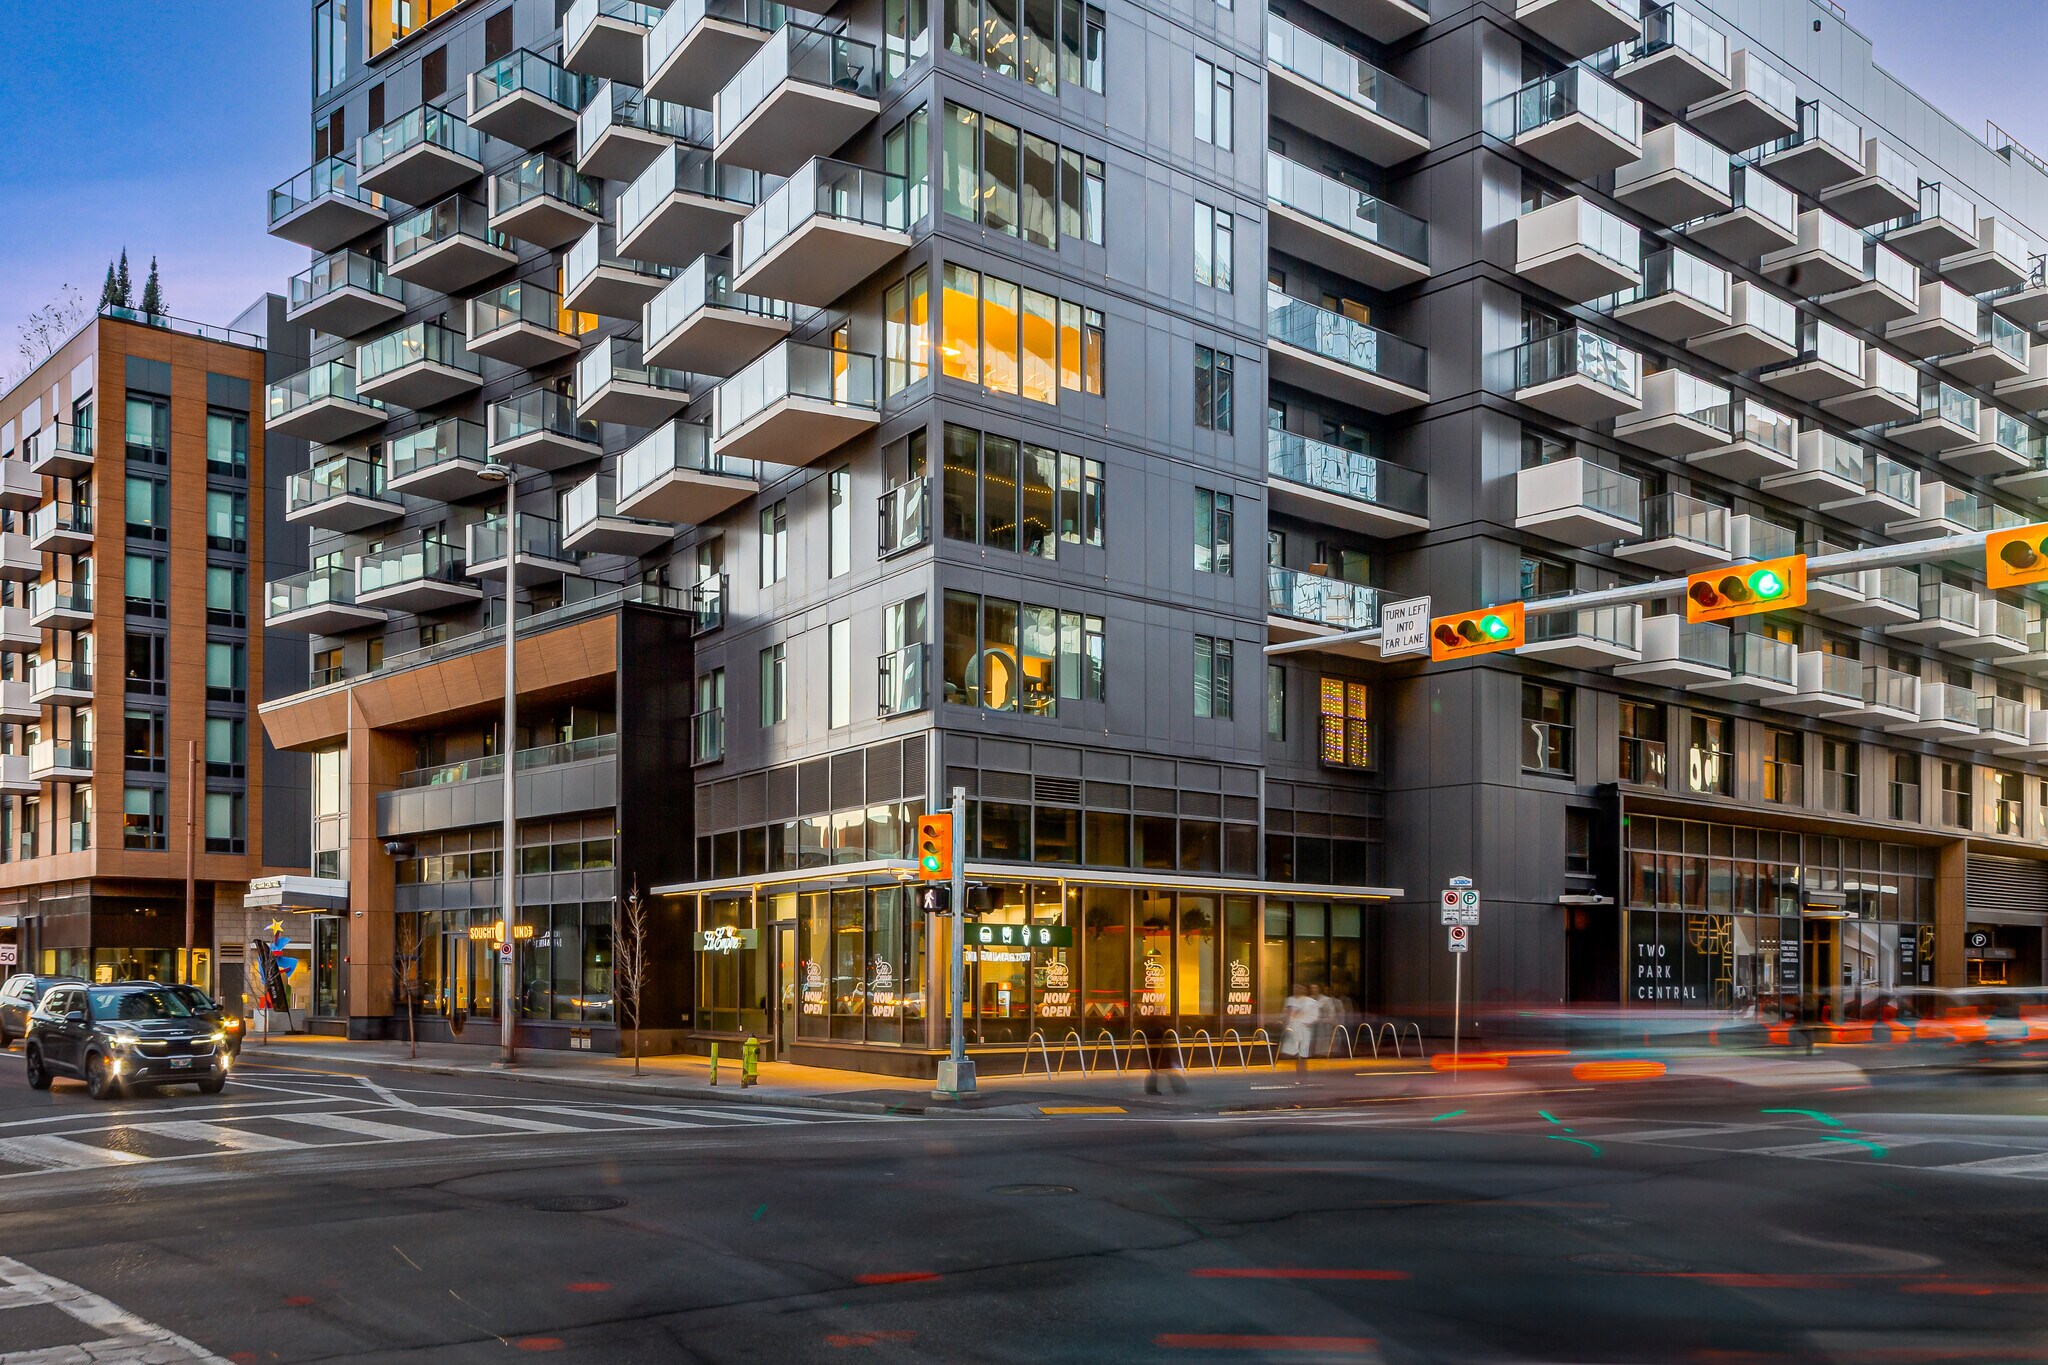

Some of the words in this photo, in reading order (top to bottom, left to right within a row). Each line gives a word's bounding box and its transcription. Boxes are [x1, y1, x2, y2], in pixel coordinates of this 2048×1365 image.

[1386, 608, 1405, 620] TURN
[1408, 604, 1427, 616] LEFT
[1396, 620, 1414, 633] INTO
[1386, 638, 1400, 649] FAR
[1403, 633, 1424, 646] LANE
[470, 927, 495, 940] SOUGHT
[0, 952, 15, 961] 50
[1638, 944, 1666, 957] TWO
[1638, 965, 1671, 978] PARK
[804, 991, 822, 1002] NOW
[873, 992, 894, 1004] NOW
[1043, 992, 1070, 1004] NOW
[1142, 992, 1166, 1003] NOW
[1228, 992, 1251, 1003] NOW
[1638, 986, 1696, 999] CENTRAL
[803, 1003, 823, 1015] OPEN
[872, 1005, 895, 1017] OPEN
[1041, 1005, 1072, 1017] OPEN
[1140, 1005, 1167, 1016] OPEN
[1226, 1004, 1252, 1015] OPEN
